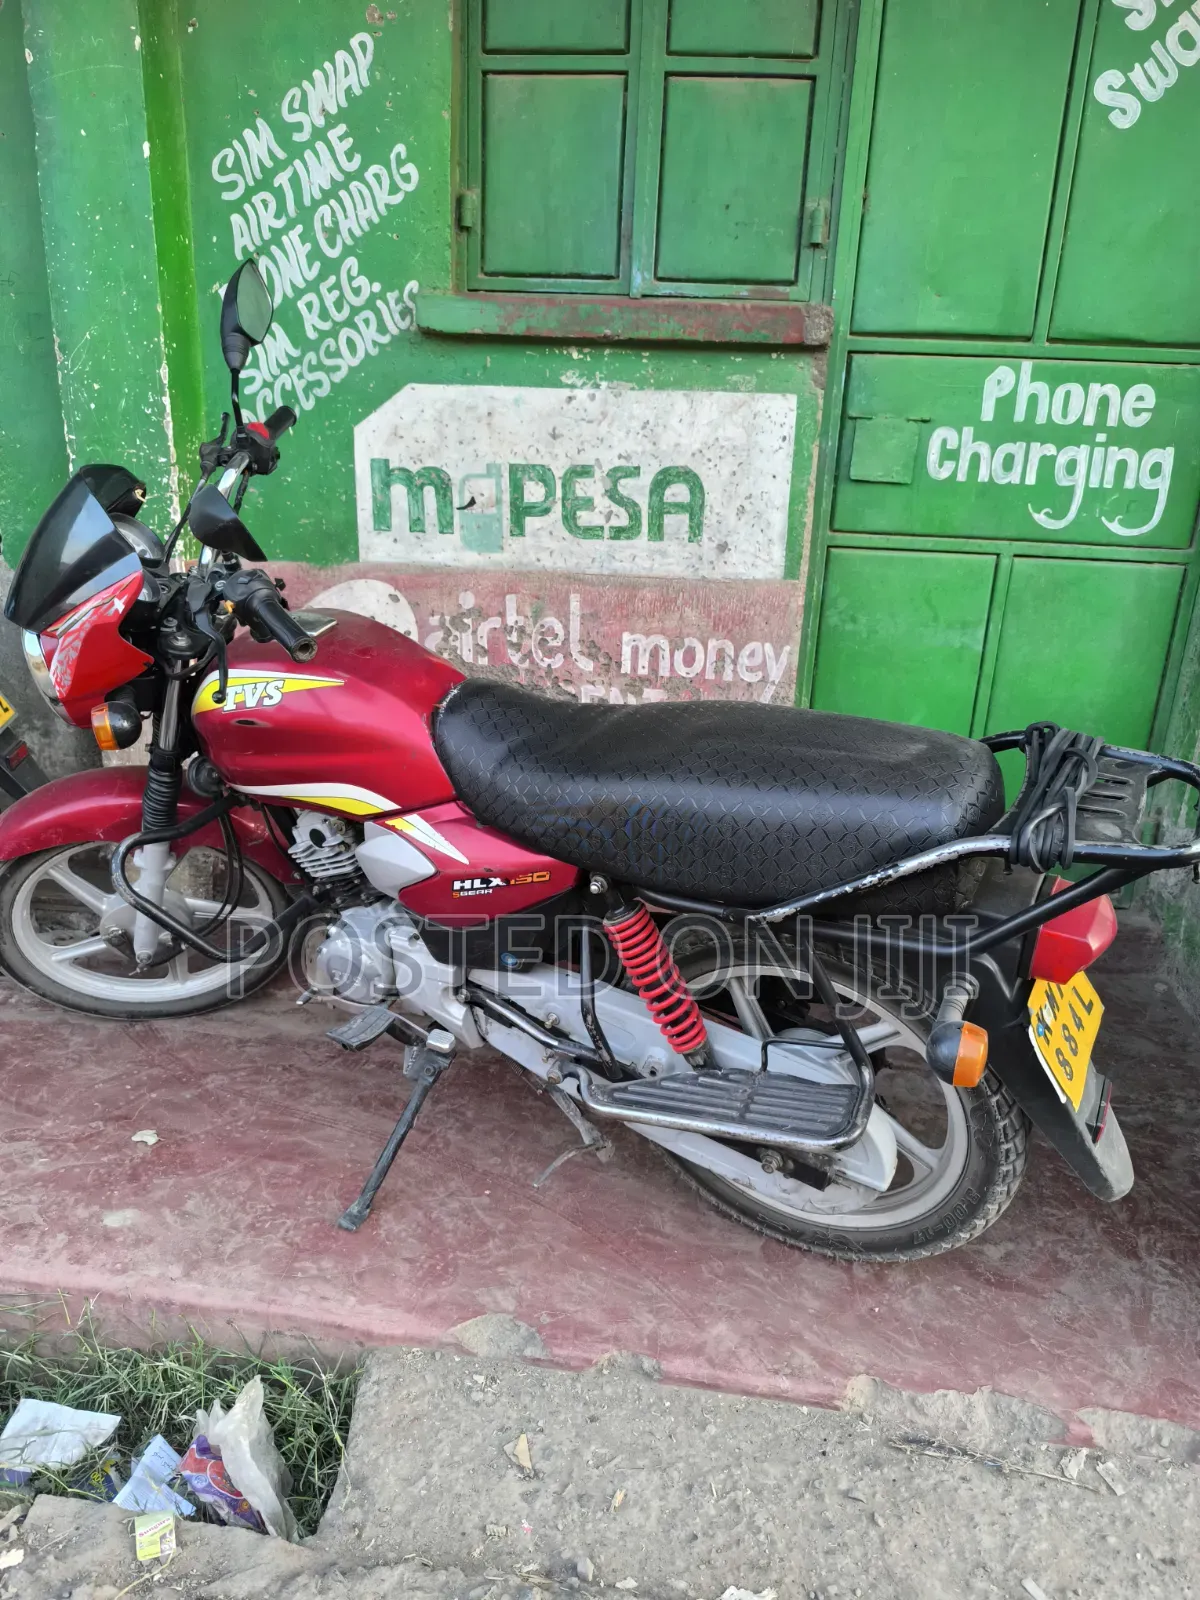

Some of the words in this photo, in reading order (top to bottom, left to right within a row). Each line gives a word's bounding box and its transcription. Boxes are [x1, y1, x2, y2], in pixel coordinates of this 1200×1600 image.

[211, 117, 287, 201] SIM
[281, 32, 375, 142] SWAP
[1094, 0, 1200, 129] Swa
[218, 224, 322, 309] ONE
[313, 143, 419, 259] CHARG
[230, 124, 362, 260] AIRTIME
[239, 322, 301, 395] SIM
[297, 256, 382, 340] REG.
[980, 361, 1156, 428] Phone
[926, 426, 1175, 536] Charging
[223, 680, 285, 712] TVS
[424, 591, 594, 672] airtel
[620, 631, 791, 704] money
[452, 877, 507, 891] HLX
[1055, 985, 1095, 1083] 884L
